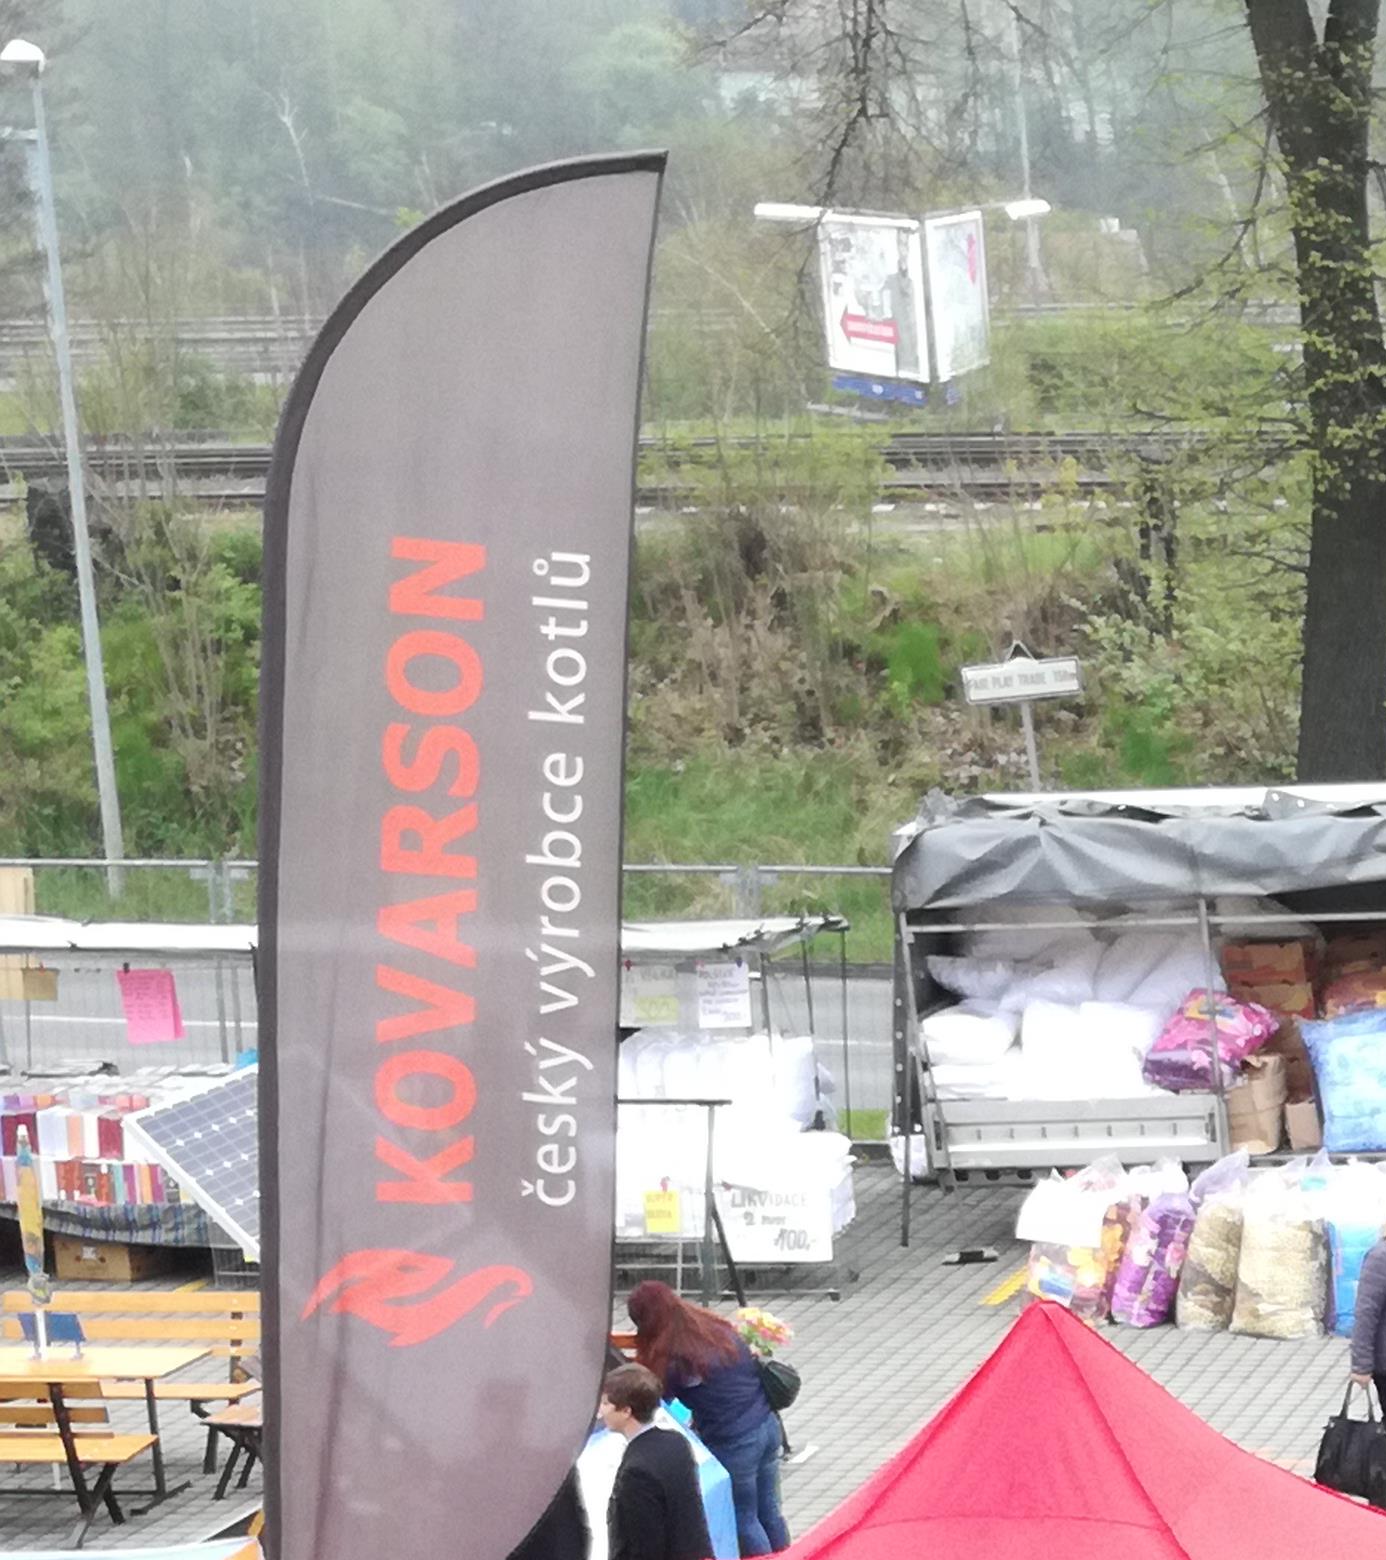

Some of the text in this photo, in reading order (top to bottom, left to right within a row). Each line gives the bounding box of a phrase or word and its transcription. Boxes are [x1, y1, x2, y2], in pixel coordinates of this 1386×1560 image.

[375, 538, 486, 1204] KOVARSON
[521, 551, 596, 1208] český výrobce kotlů
